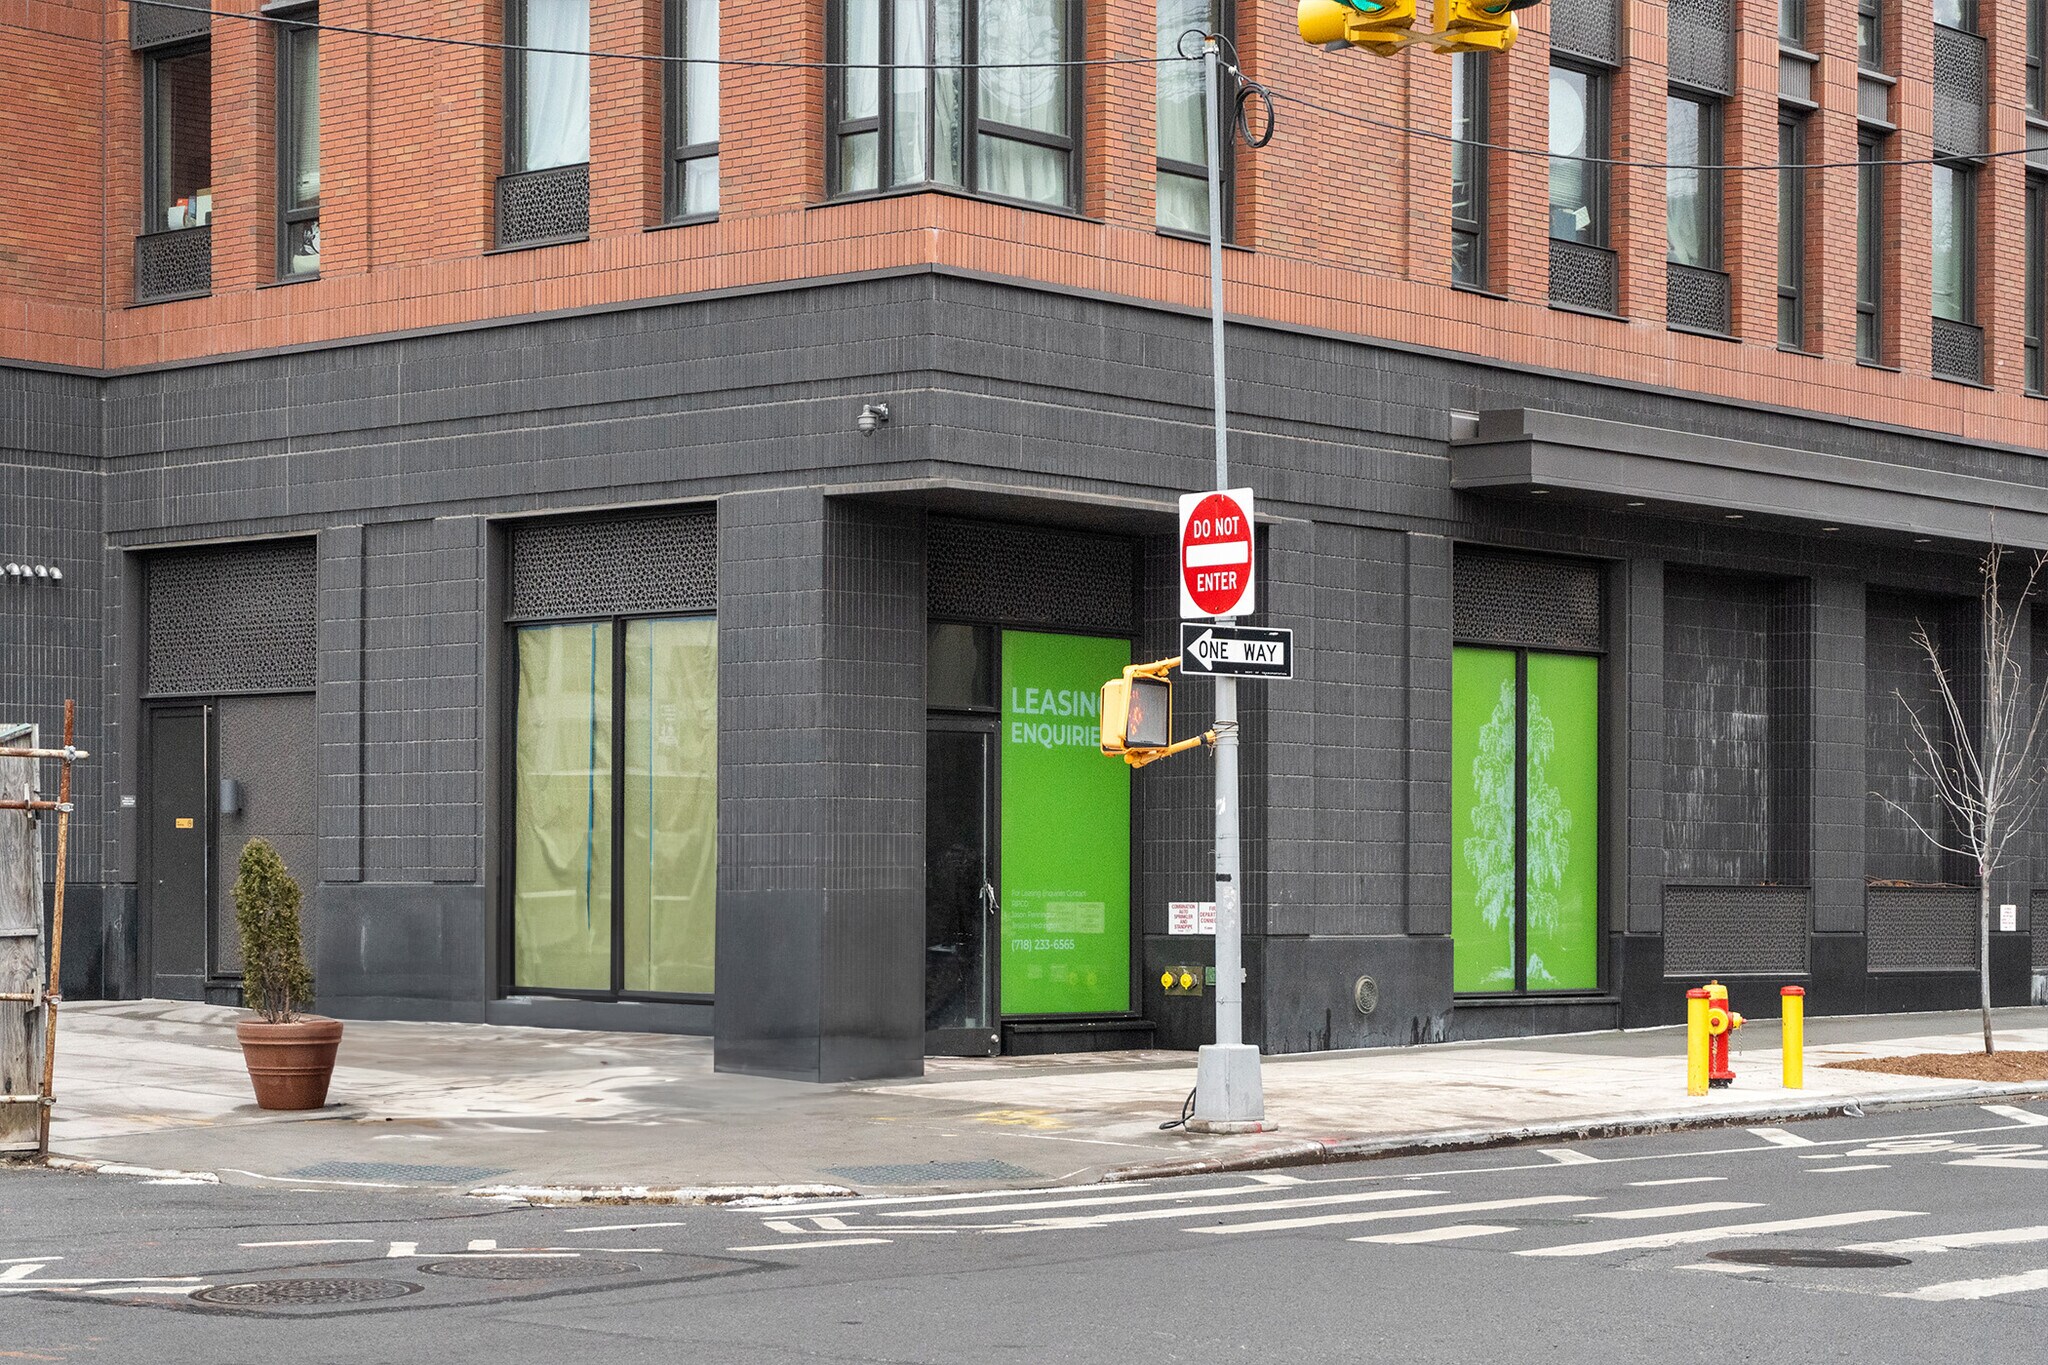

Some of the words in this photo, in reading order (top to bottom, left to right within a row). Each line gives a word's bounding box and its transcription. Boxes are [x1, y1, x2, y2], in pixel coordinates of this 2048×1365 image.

[1193, 518, 1211, 539] DO
[1215, 516, 1240, 537] NOT
[1197, 571, 1238, 592] ENTER
[1198, 640, 1229, 659] ONE
[1243, 643, 1277, 662] WAY
[1012, 687, 1100, 717] LEASIN
[1011, 722, 1100, 749] ENQUIRIE
[1011, 939, 1032, 952] (718)
[1034, 939, 1075, 950] 233-6565
